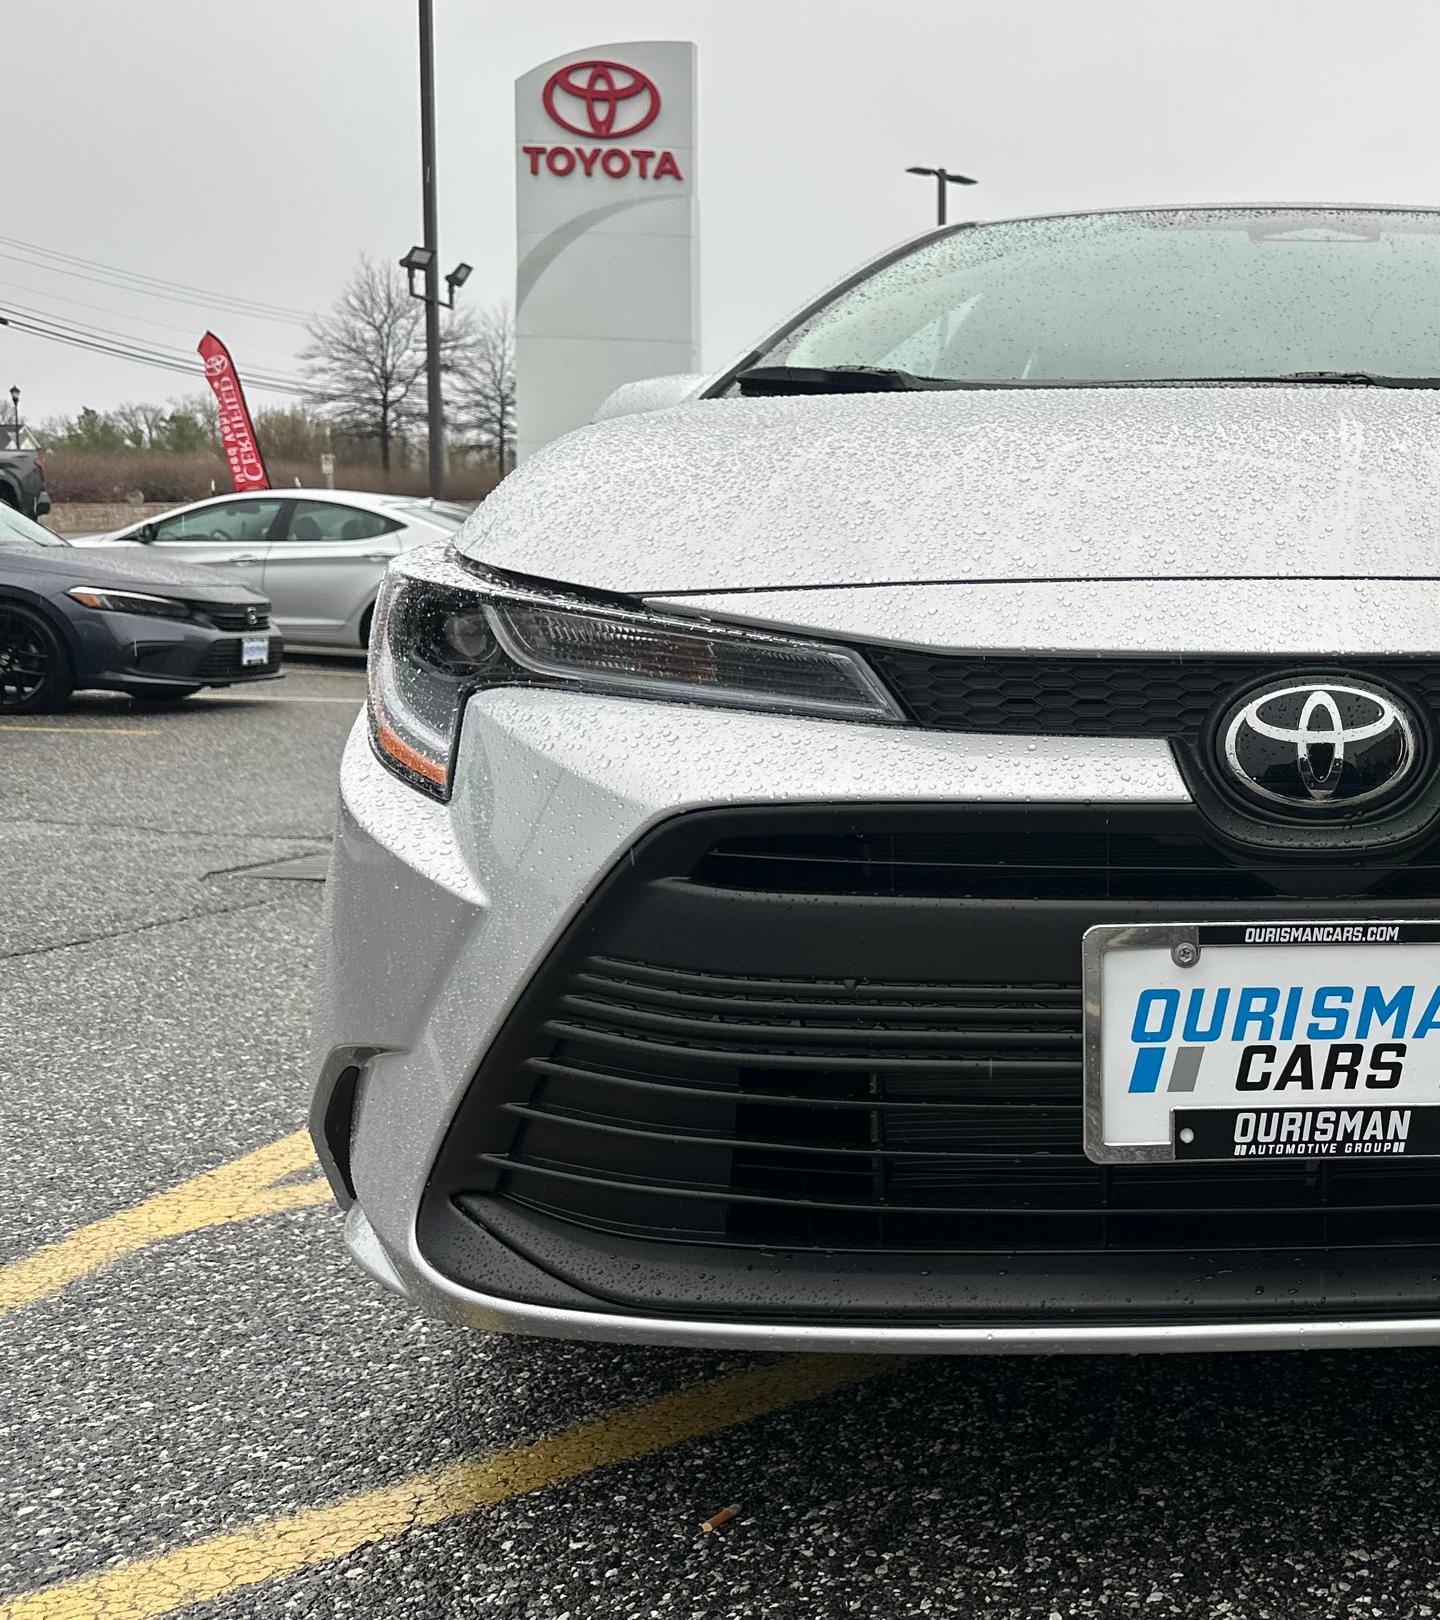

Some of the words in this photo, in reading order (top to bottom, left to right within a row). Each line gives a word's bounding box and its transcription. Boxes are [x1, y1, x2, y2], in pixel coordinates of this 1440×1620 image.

[522, 146, 682, 181] TOYOTA
[1244, 926, 1400, 943] OURISMANCARS.COM
[1234, 1043, 1407, 1092] CARS
[1233, 1110, 1412, 1143] OURISMAN
[1248, 1143, 1337, 1156] AUTOMOTIVE
[1344, 1142, 1392, 1154] GROUP
